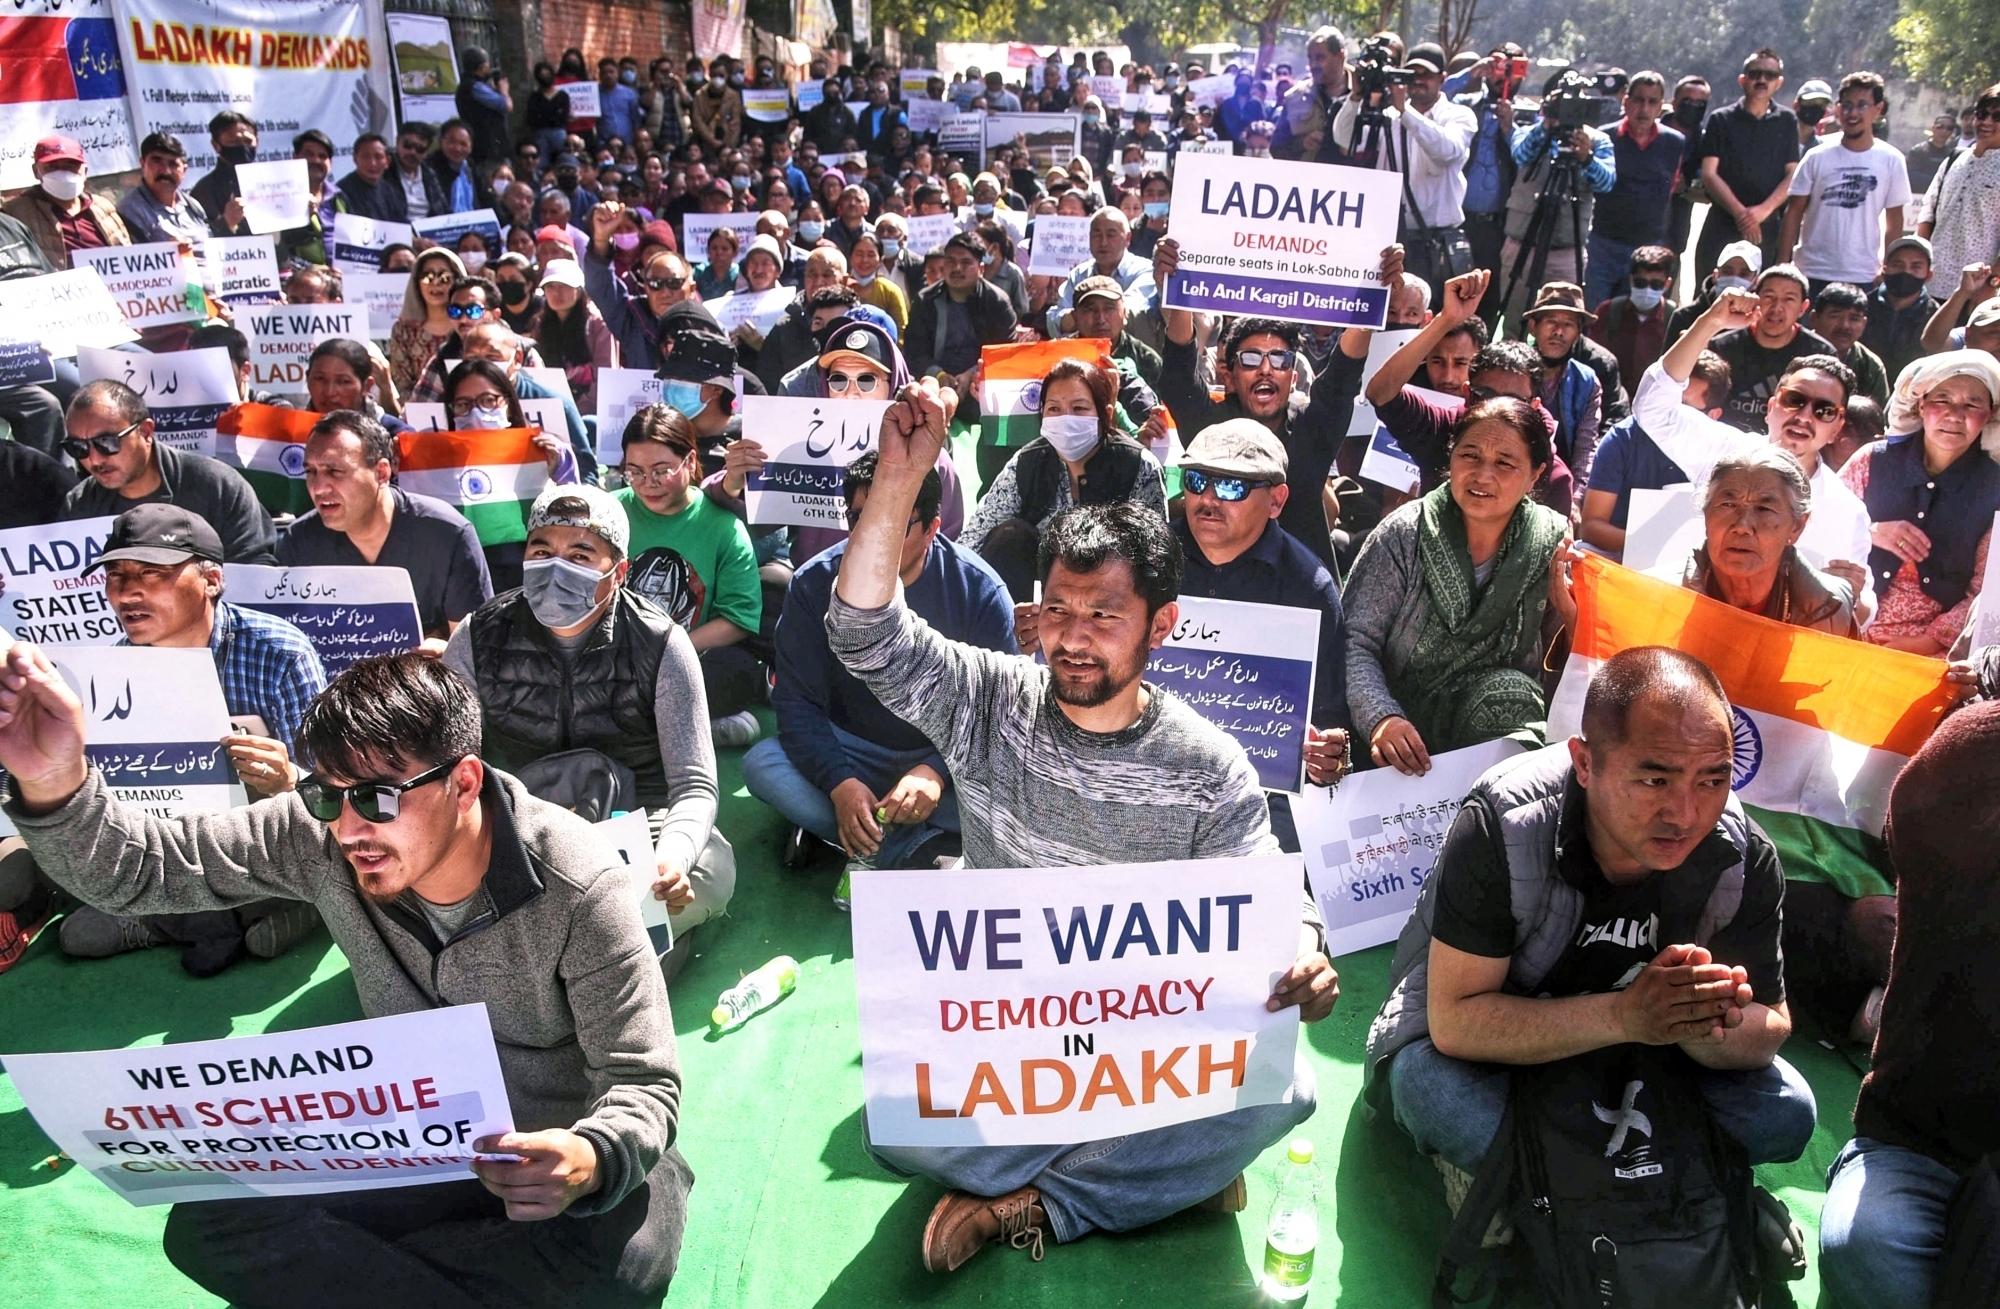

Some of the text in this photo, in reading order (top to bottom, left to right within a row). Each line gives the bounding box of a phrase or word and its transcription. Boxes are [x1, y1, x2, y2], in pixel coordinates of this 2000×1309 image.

[131, 17, 371, 70] LADAKH DEMANDS
[1201, 179, 1365, 228] LADAKH
[1233, 231, 1328, 256] DEMANDS
[89, 251, 177, 276] WE WANT
[1179, 250, 1236, 269] Separate
[1239, 258, 1274, 272] seats
[1277, 260, 1289, 272] in
[1293, 261, 1359, 279] Lok-Sabha
[117, 294, 191, 320] ADAKH
[136, 291, 146, 299] IN
[1181, 280, 1370, 313] Leh And Kargil Districts
[251, 314, 353, 335] WE WANT
[254, 362, 304, 384] LAD
[806, 408, 871, 458] لداخ
[792, 495, 835, 507] LADAKH
[803, 508, 825, 519] 6TH
[1, 534, 107, 576] LADA
[53, 573, 107, 591] DEMAN
[265, 571, 337, 600] ہماری مانگیں
[13, 591, 108, 620] STATEH
[15, 622, 81, 644] SIXTH
[1172, 618, 1221, 642] ہماری
[1161, 662, 1196, 679] ریاست
[1197, 656, 1226, 679] مکمل
[1233, 663, 1259, 683] لداخ
[91, 674, 132, 721] لدا
[113, 788, 184, 802] EMANDS
[1351, 872, 1405, 901] Sixth
[908, 894, 1252, 971] WE WANT
[939, 977, 1215, 1032] DEMOCRACY
[1063, 1033, 1094, 1057] IN
[127, 1045, 374, 1090] WE DEMAND
[915, 1040, 1247, 1119] LADAKH
[104, 1077, 440, 1131] 6TH SCHEDULE
[97, 1119, 472, 1156] FOR PROTECTION OF
[121, 1158, 317, 1173] CULTURAL
